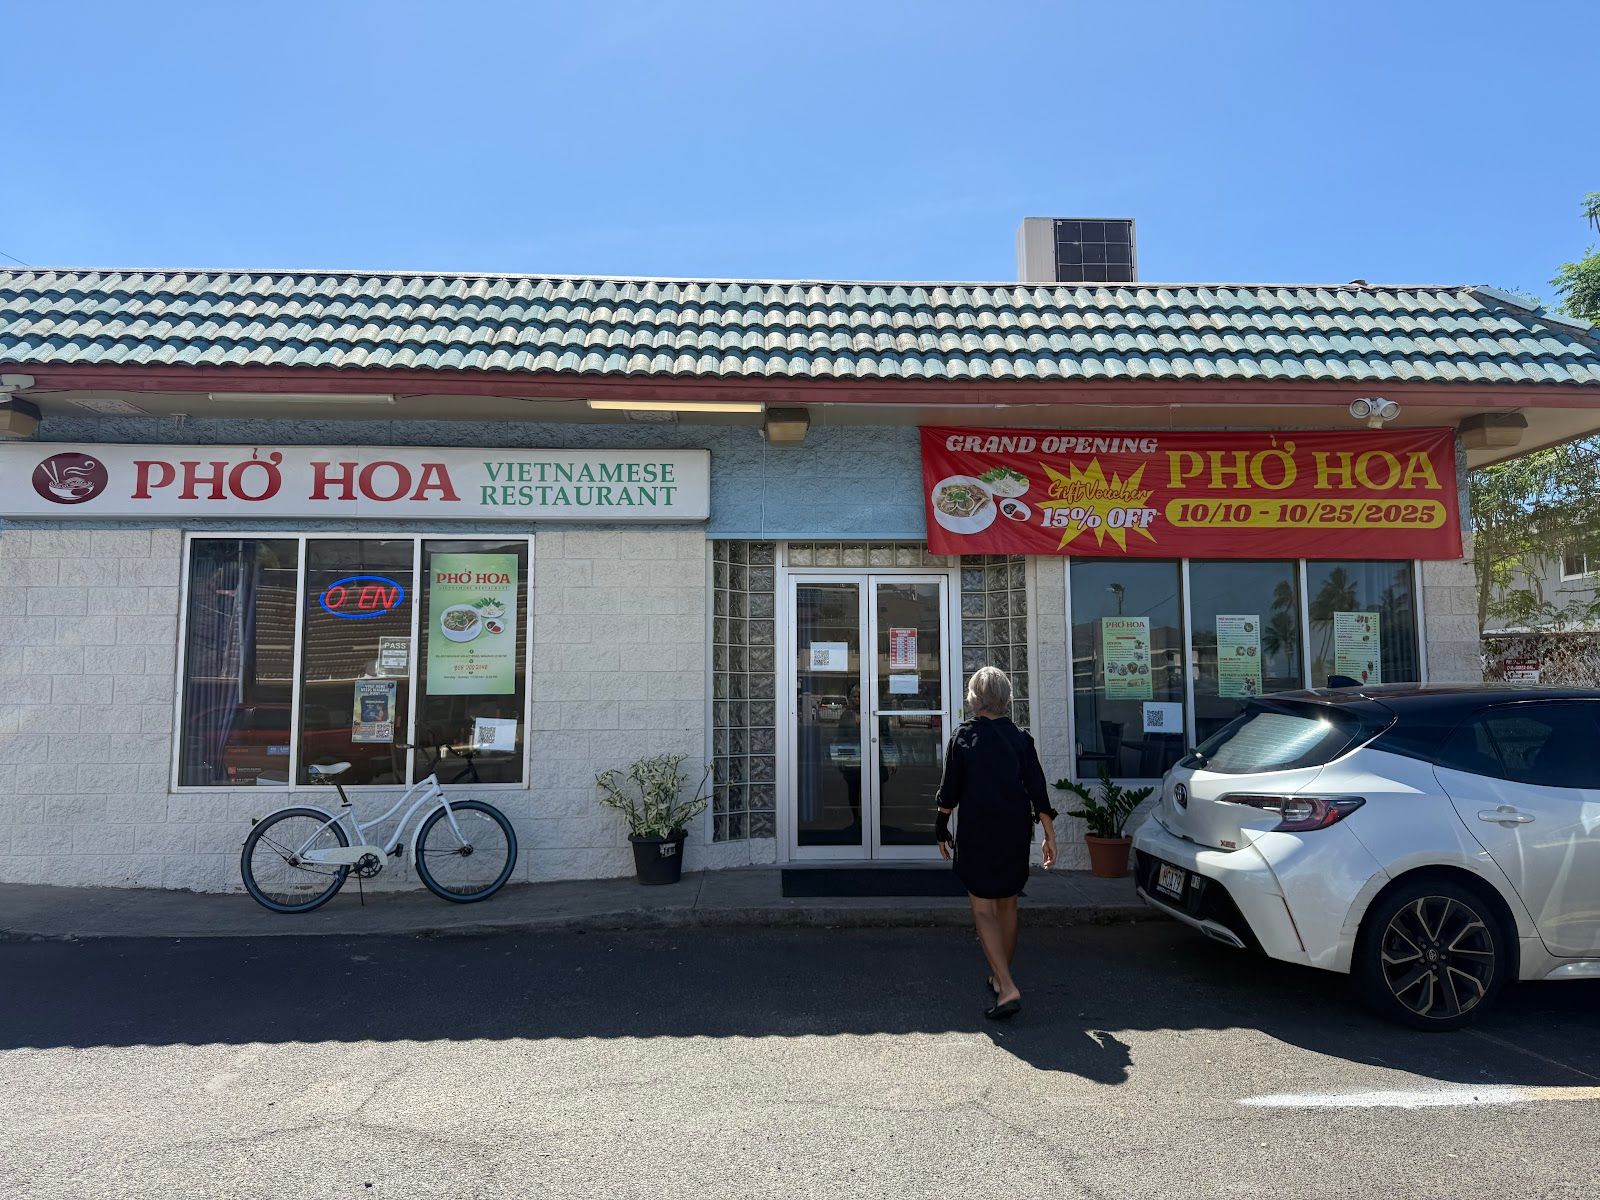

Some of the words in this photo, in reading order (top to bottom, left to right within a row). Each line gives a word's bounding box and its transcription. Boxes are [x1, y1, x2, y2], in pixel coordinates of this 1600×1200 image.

[946, 435, 1036, 454] GRAND
[1041, 436, 1159, 454] OPENING
[483, 462, 675, 483] VIETNAMESE
[1165, 434, 1298, 490] PHỞ
[1312, 451, 1443, 490] HOA
[131, 448, 283, 502] PHỞ
[309, 461, 461, 502] HOA
[480, 485, 677, 506] RESTAURANT
[1048, 479, 1086, 504] Gift
[1083, 480, 1153, 503] Voucher
[1041, 506, 1103, 530] 15%
[1106, 507, 1157, 528] OFF
[1177, 502, 1252, 524] 10/10
[1276, 502, 1436, 524] 10/25/2025
[476, 573, 511, 584] HOA
[325, 586, 398, 609] OEN
[384, 642, 407, 650] PASS
